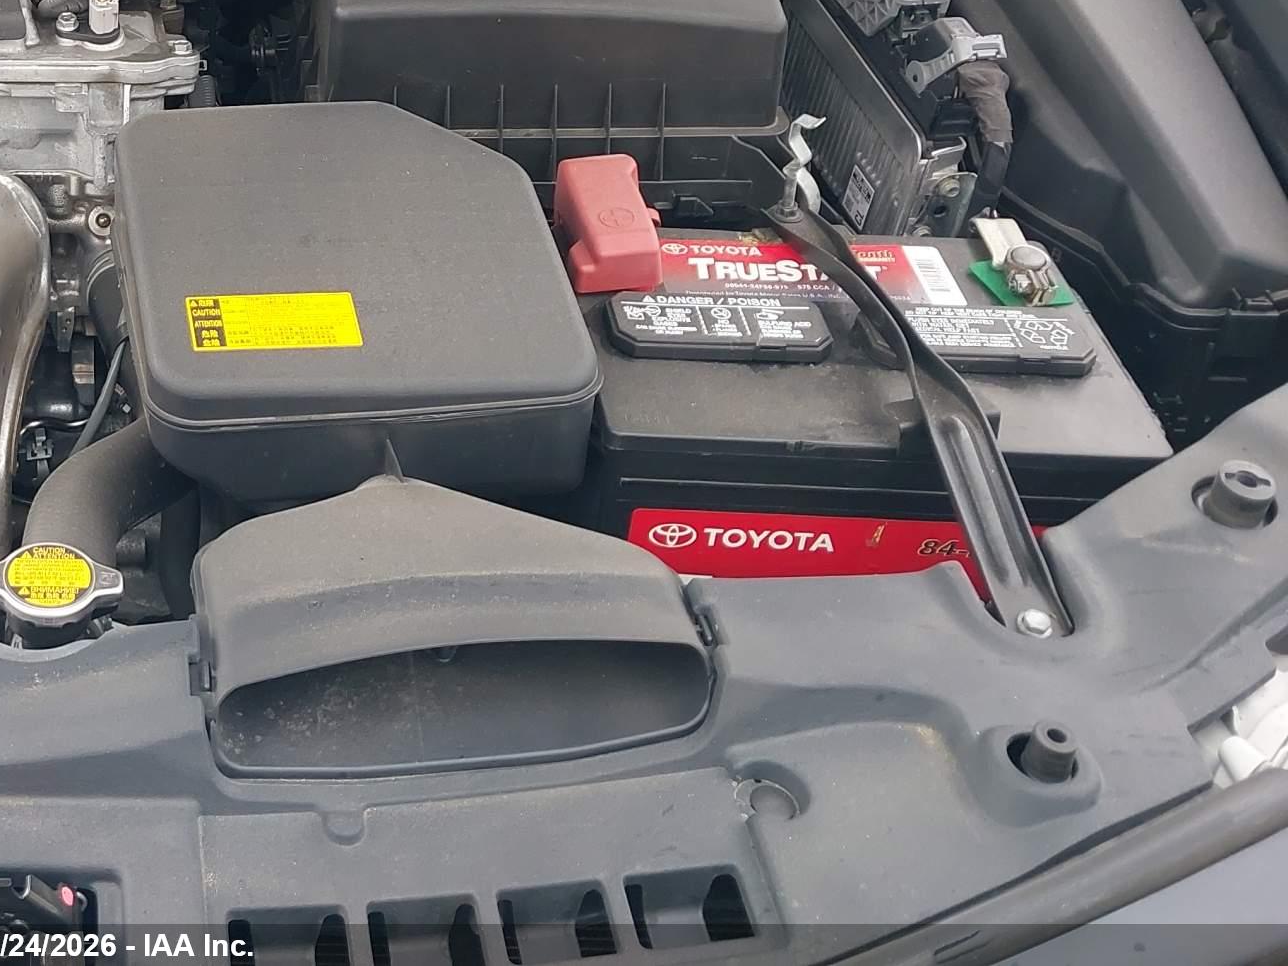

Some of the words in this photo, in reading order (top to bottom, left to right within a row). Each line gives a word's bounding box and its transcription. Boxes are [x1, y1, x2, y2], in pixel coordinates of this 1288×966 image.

[690, 245, 762, 256] TOYOTA
[656, 296, 714, 304] DANGER
[727, 298, 781, 306] POISON
[192, 308, 221, 316] CAUTION
[195, 319, 223, 328] ATTENTION
[703, 527, 835, 553] TOYOTA
[32, 546, 66, 554] CAUTION
